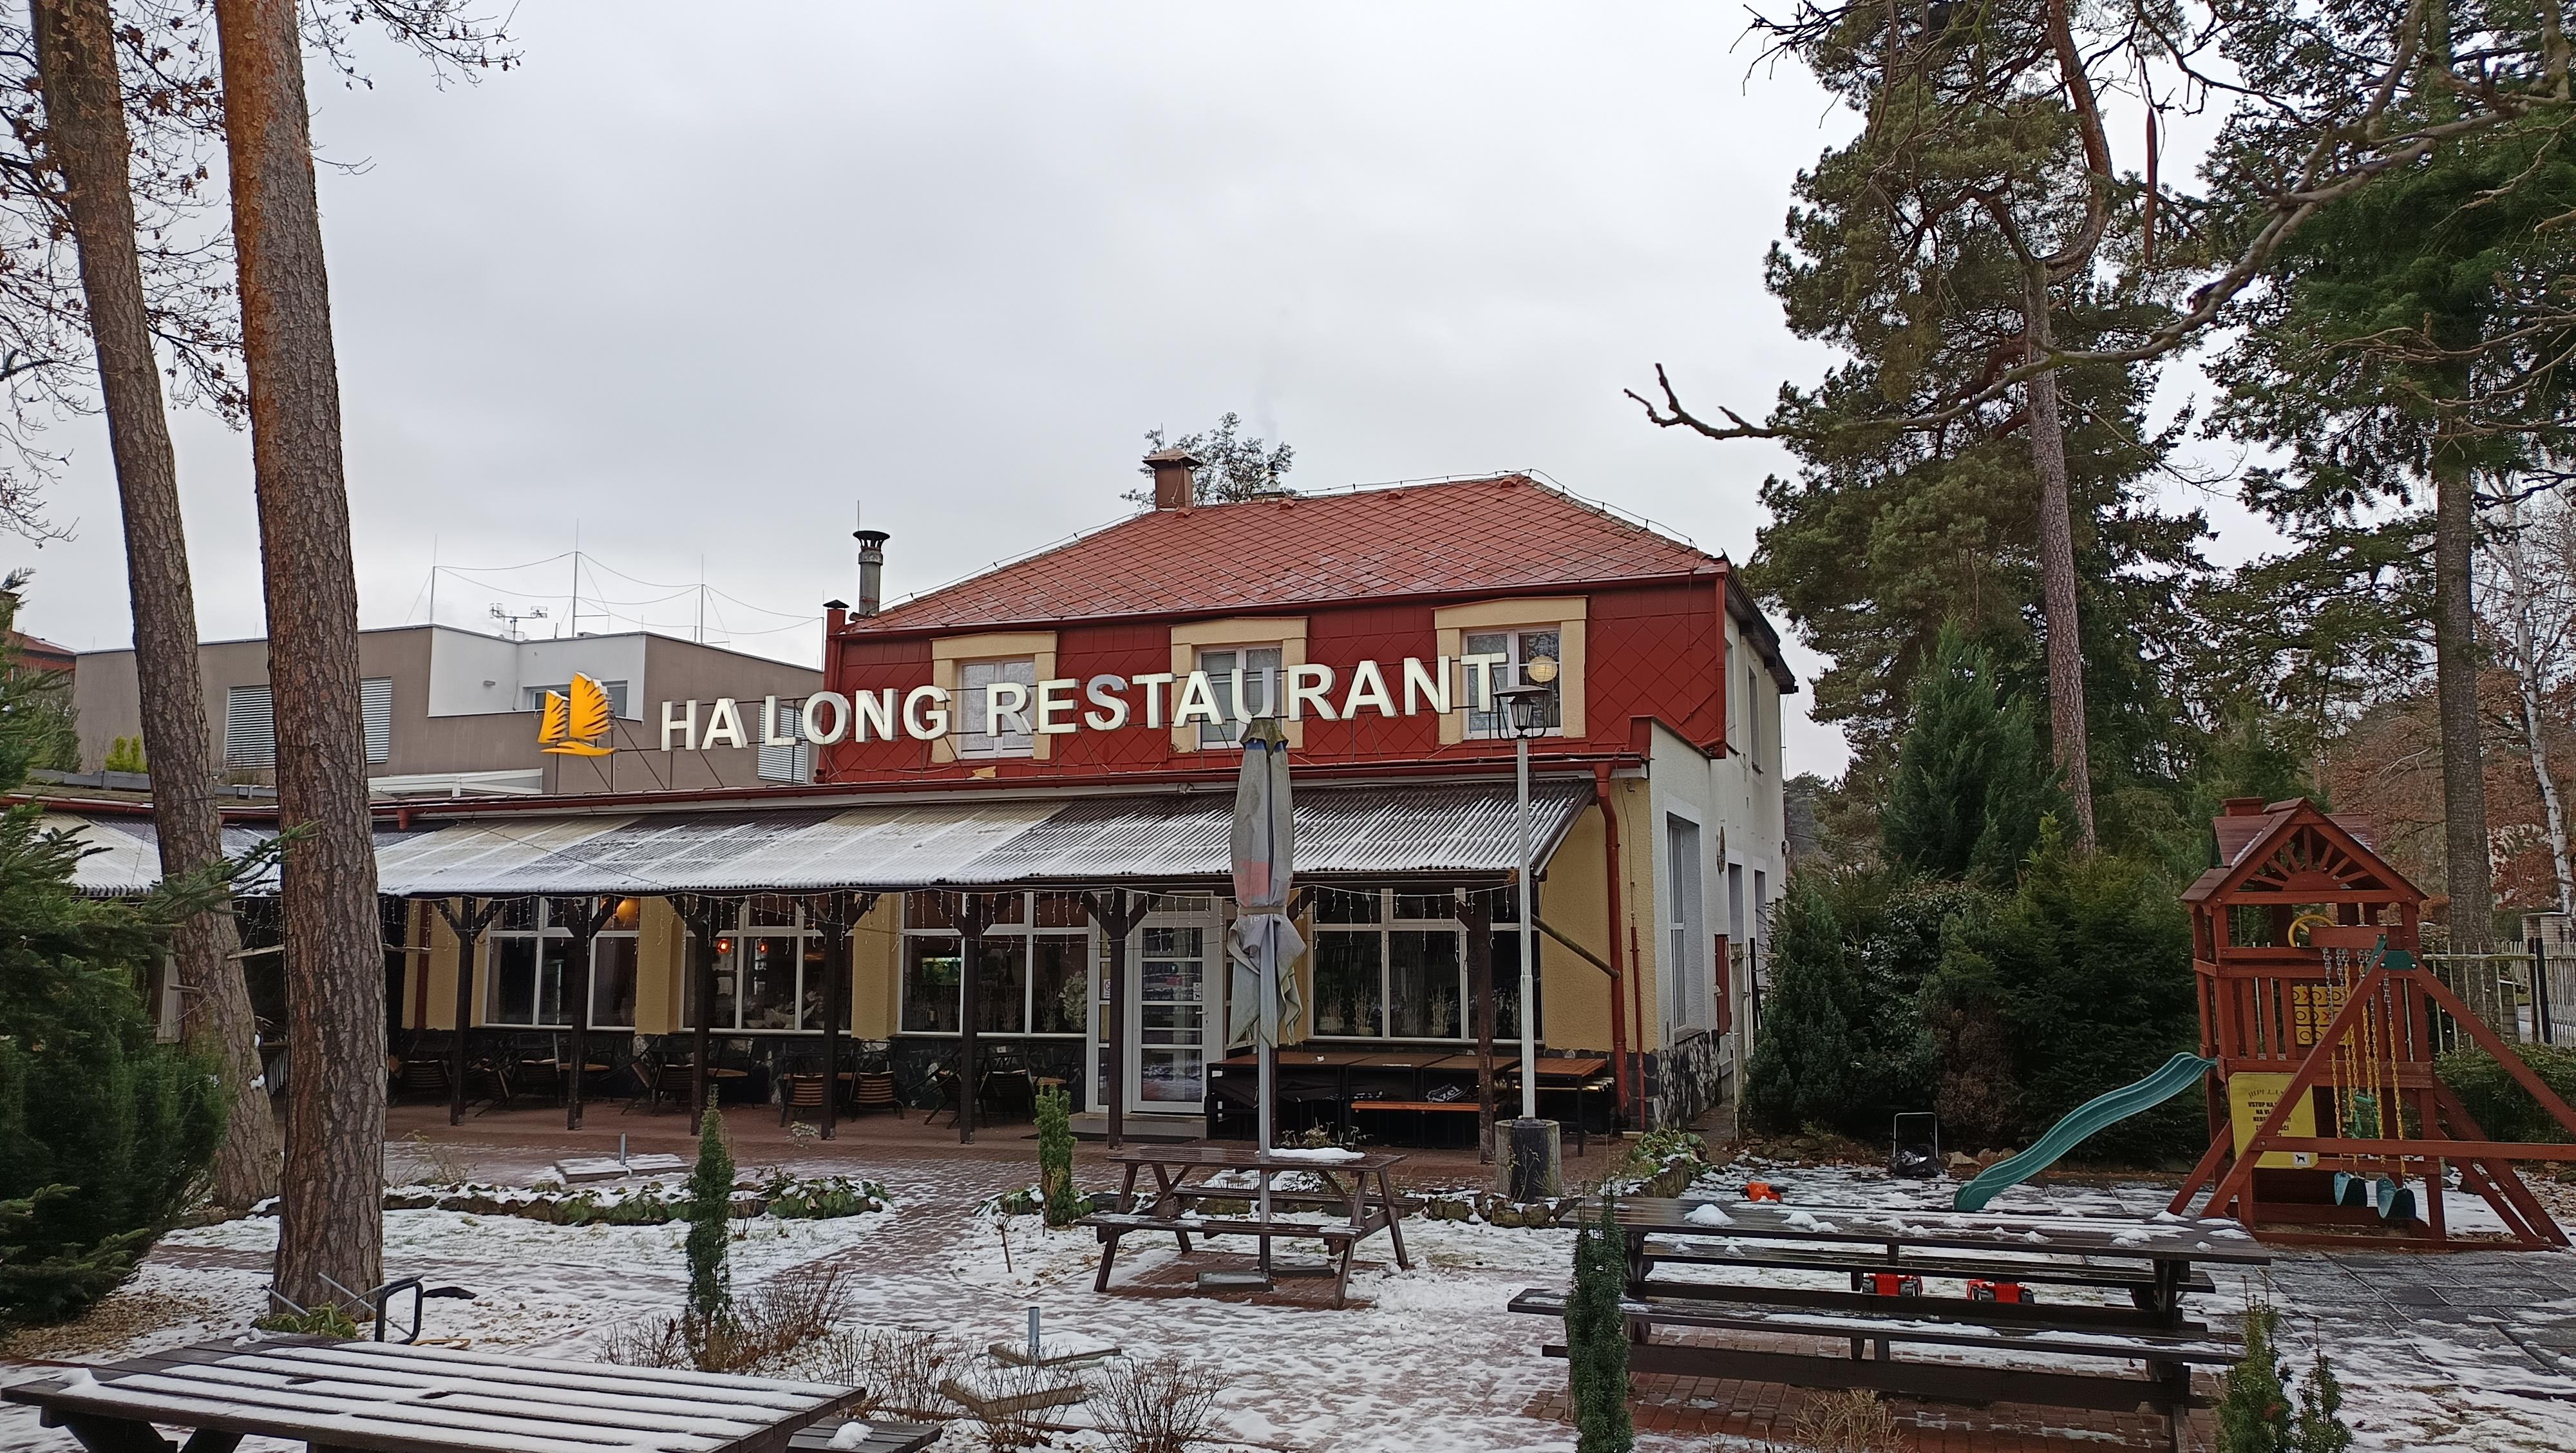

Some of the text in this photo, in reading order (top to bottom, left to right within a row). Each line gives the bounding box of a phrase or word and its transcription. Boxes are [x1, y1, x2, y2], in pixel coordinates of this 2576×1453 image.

[661, 652, 1507, 752] HA LONG RESTAURANT
